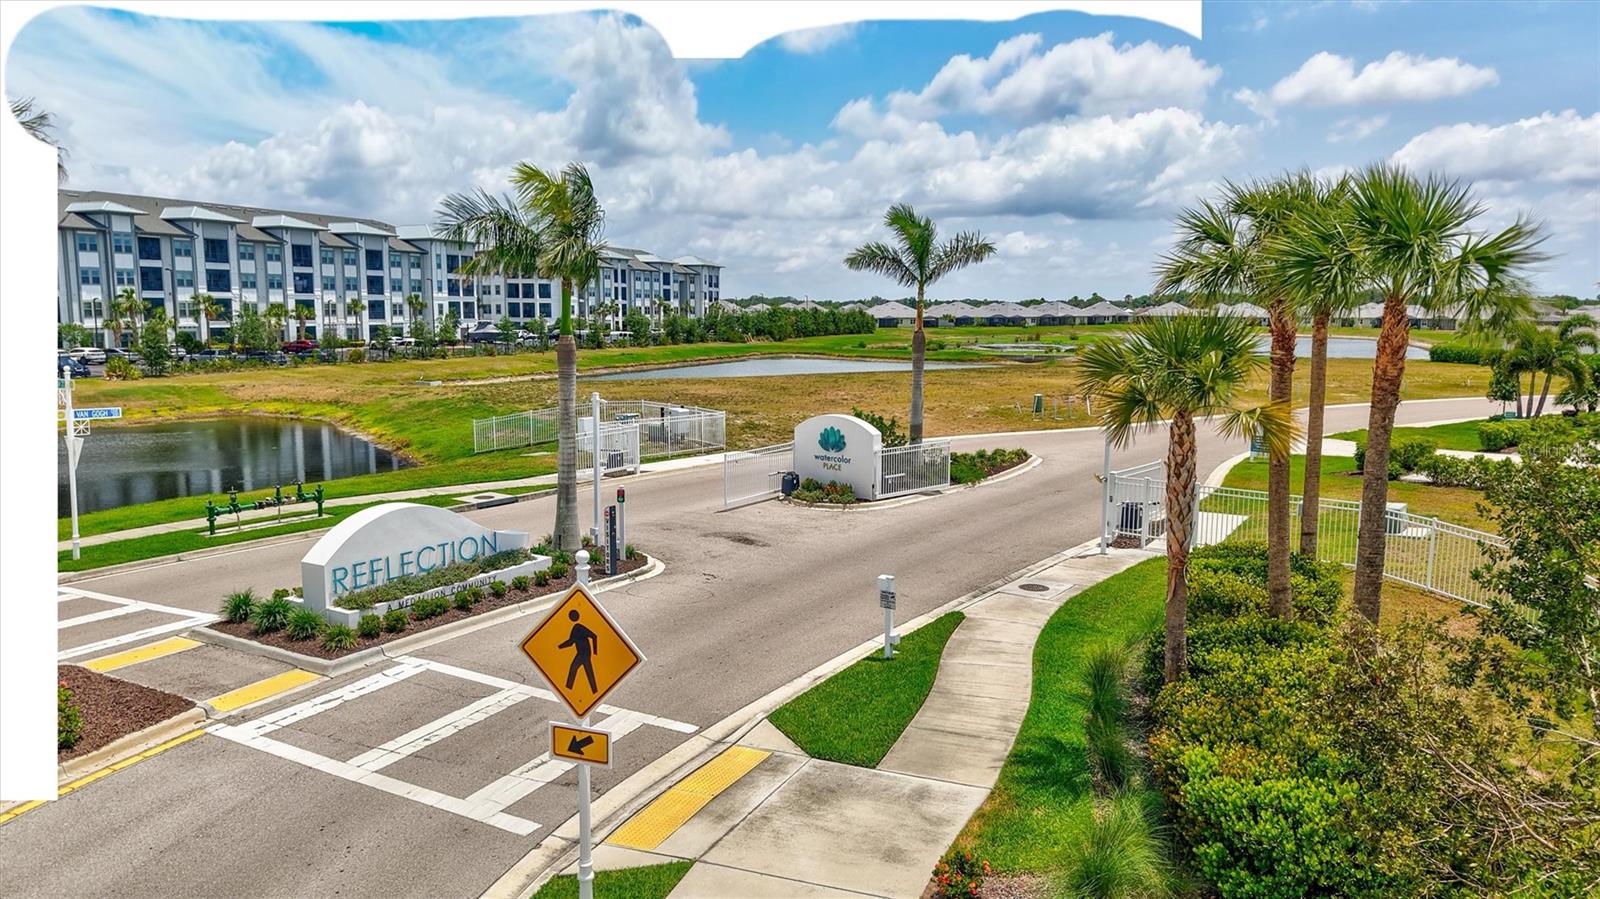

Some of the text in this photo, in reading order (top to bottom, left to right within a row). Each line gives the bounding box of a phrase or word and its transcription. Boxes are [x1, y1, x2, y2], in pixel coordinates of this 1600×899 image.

[814, 454, 852, 464] watercolor
[823, 463, 842, 471] PLACE
[331, 531, 498, 594] REFLECTION
[387, 604, 393, 612] A
[451, 575, 497, 592] COMMUNITY
